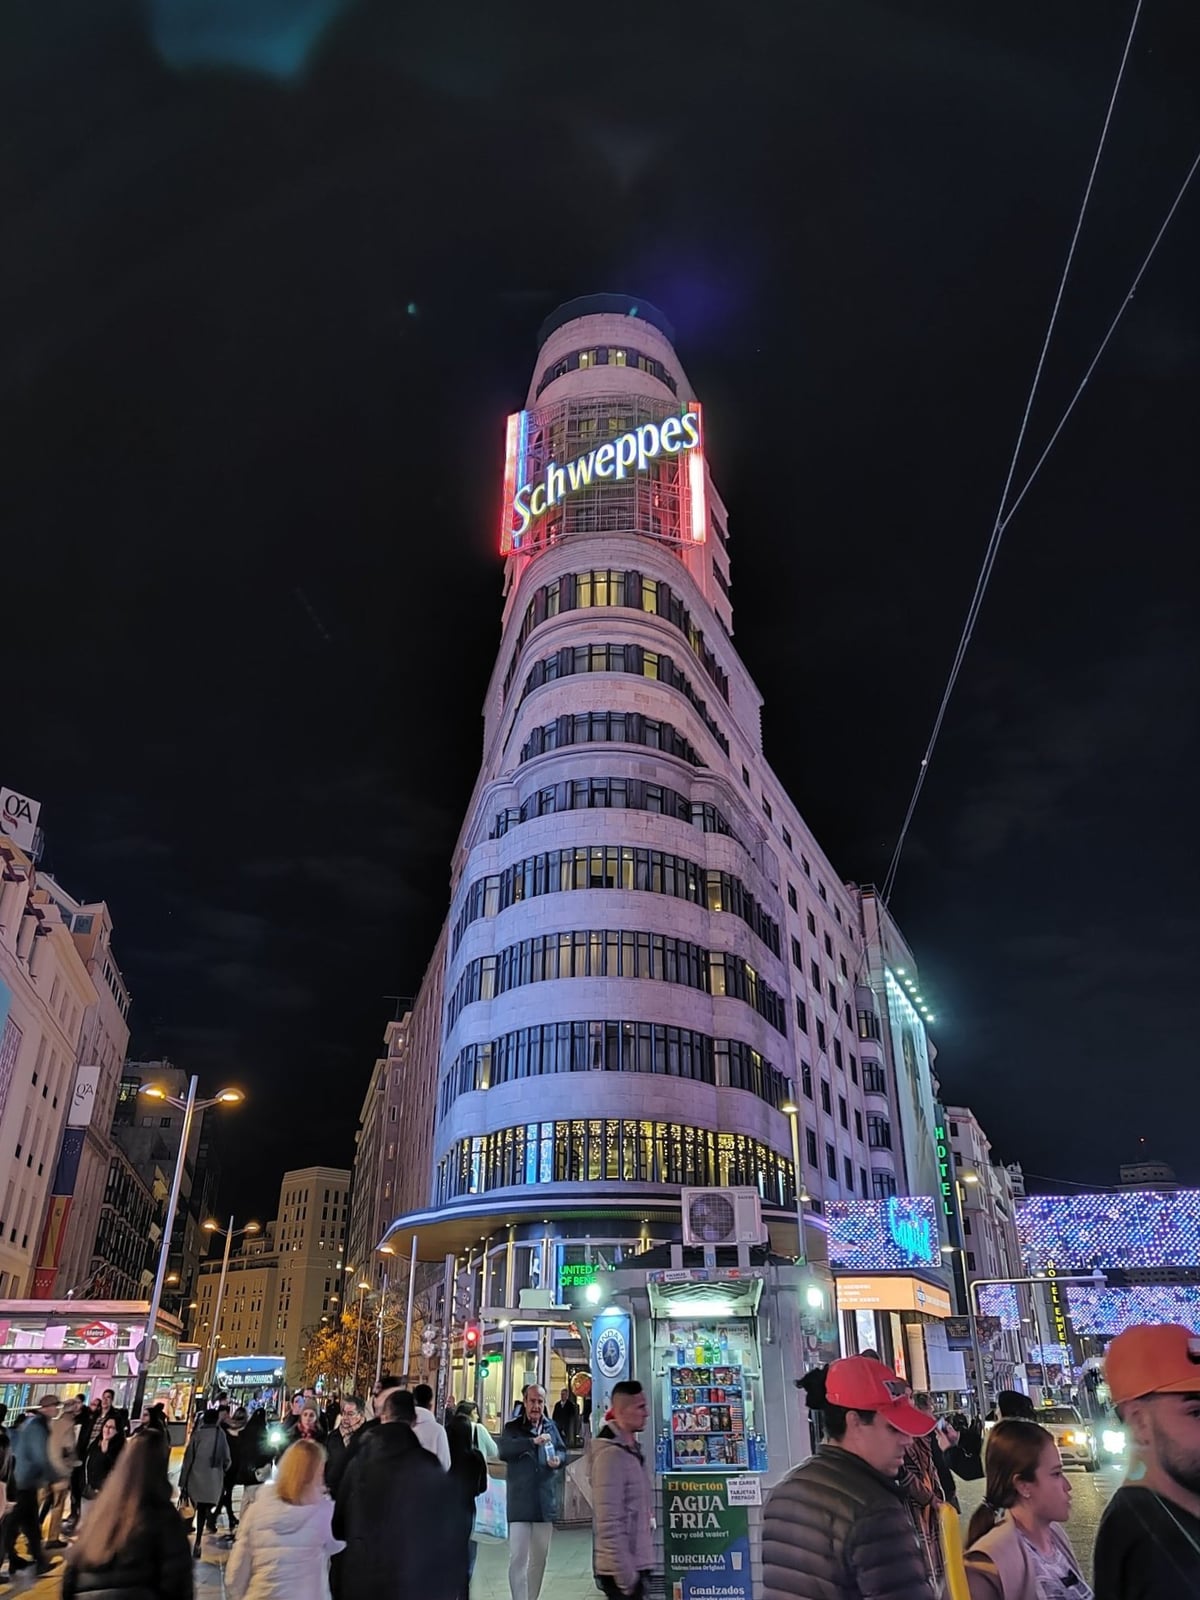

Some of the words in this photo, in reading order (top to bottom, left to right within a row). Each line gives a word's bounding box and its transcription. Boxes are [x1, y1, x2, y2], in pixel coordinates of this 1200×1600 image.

[511, 412, 699, 538] Schweppes
[934, 1126, 953, 1215] HOTEL
[560, 1265, 593, 1274] UNITED
[560, 1276, 572, 1286] OF
[668, 1481, 679, 1491] El
[670, 1495, 726, 1511] AGUA
[671, 1532, 688, 1540] Very
[705, 1530, 730, 1538] water!
[671, 1554, 726, 1564] HORCHATA
[689, 1585, 745, 1595] Granizados
